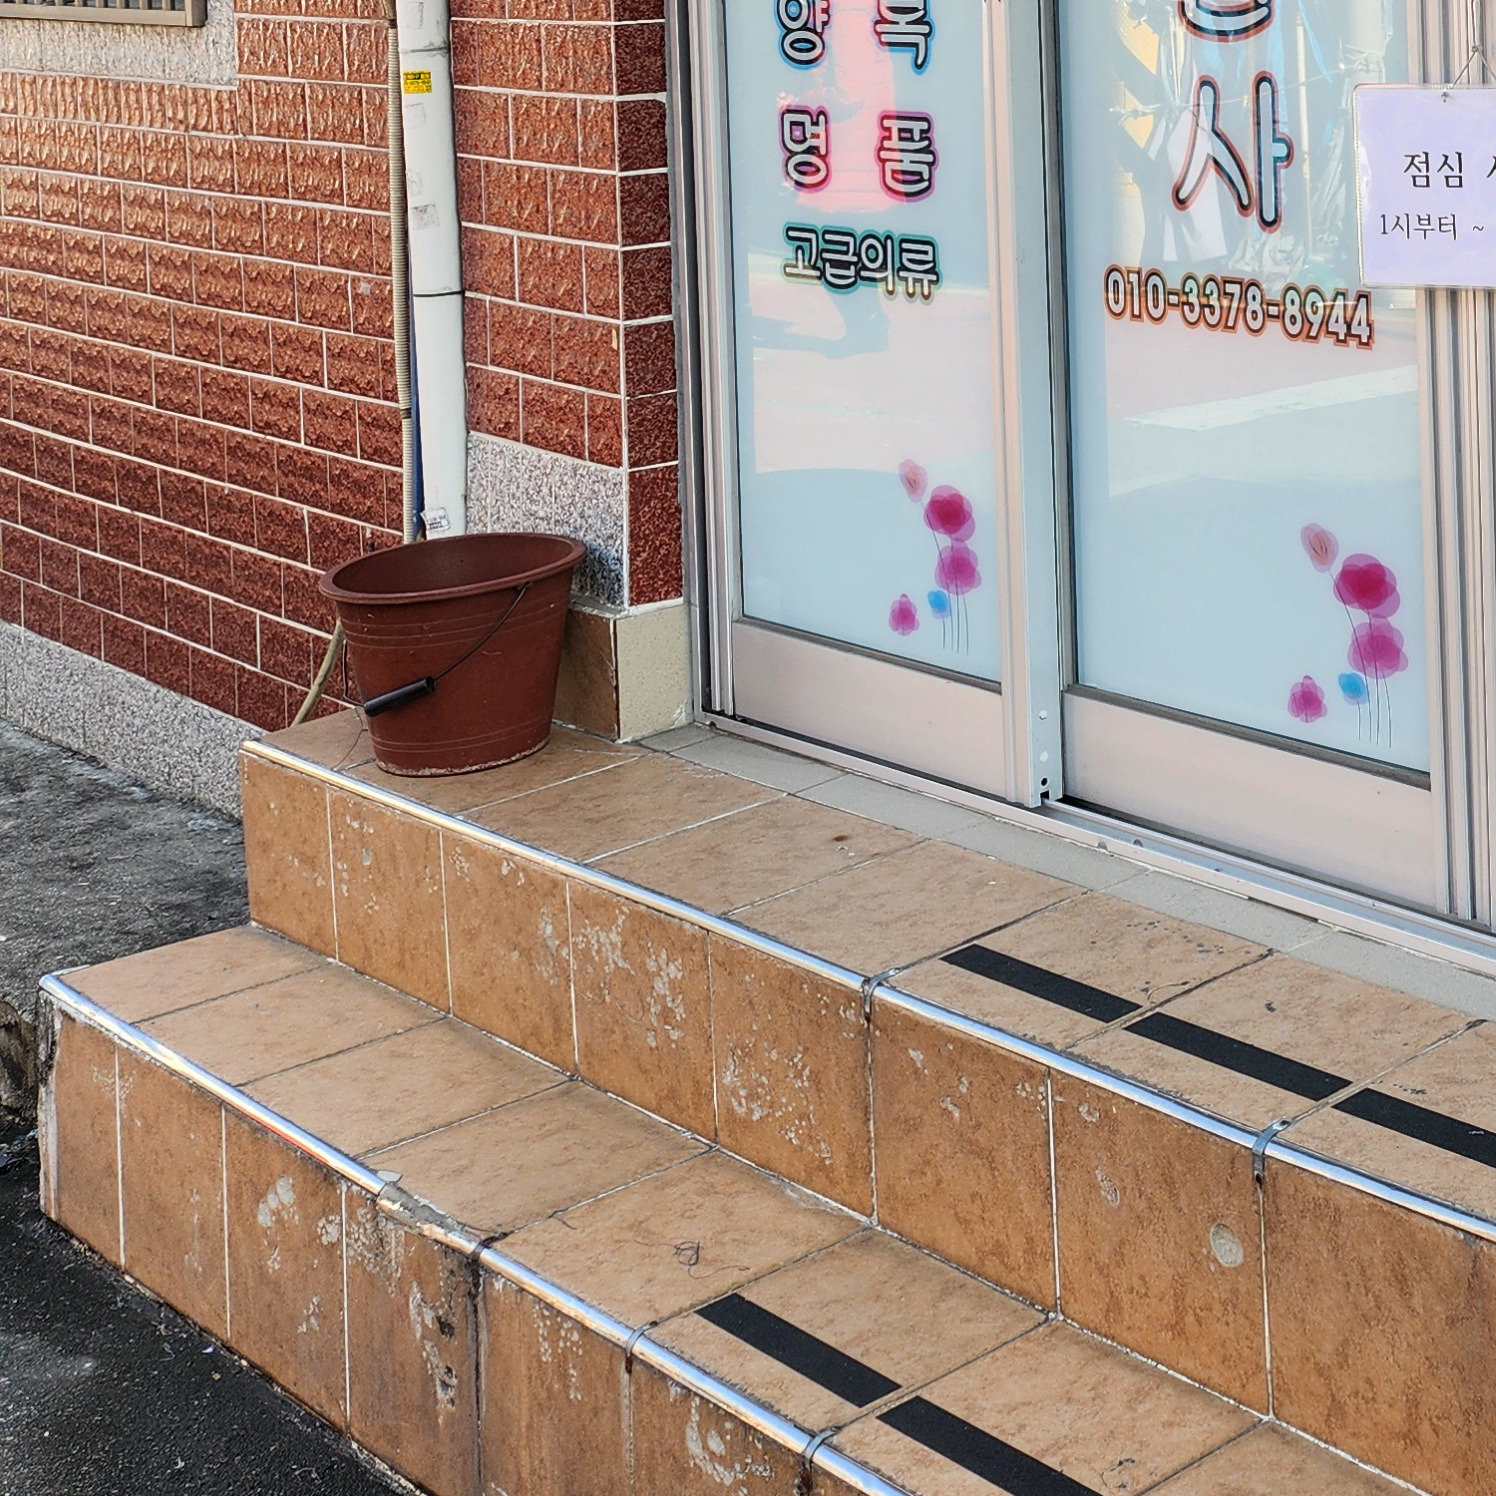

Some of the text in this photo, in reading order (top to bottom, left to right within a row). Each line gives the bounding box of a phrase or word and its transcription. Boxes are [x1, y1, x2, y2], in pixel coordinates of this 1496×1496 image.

[1403, 150, 1465, 189] 점심
[1380, 212, 1459, 242] 1시부터
[1104, 261, 1375, 351] 010-3378-8944
